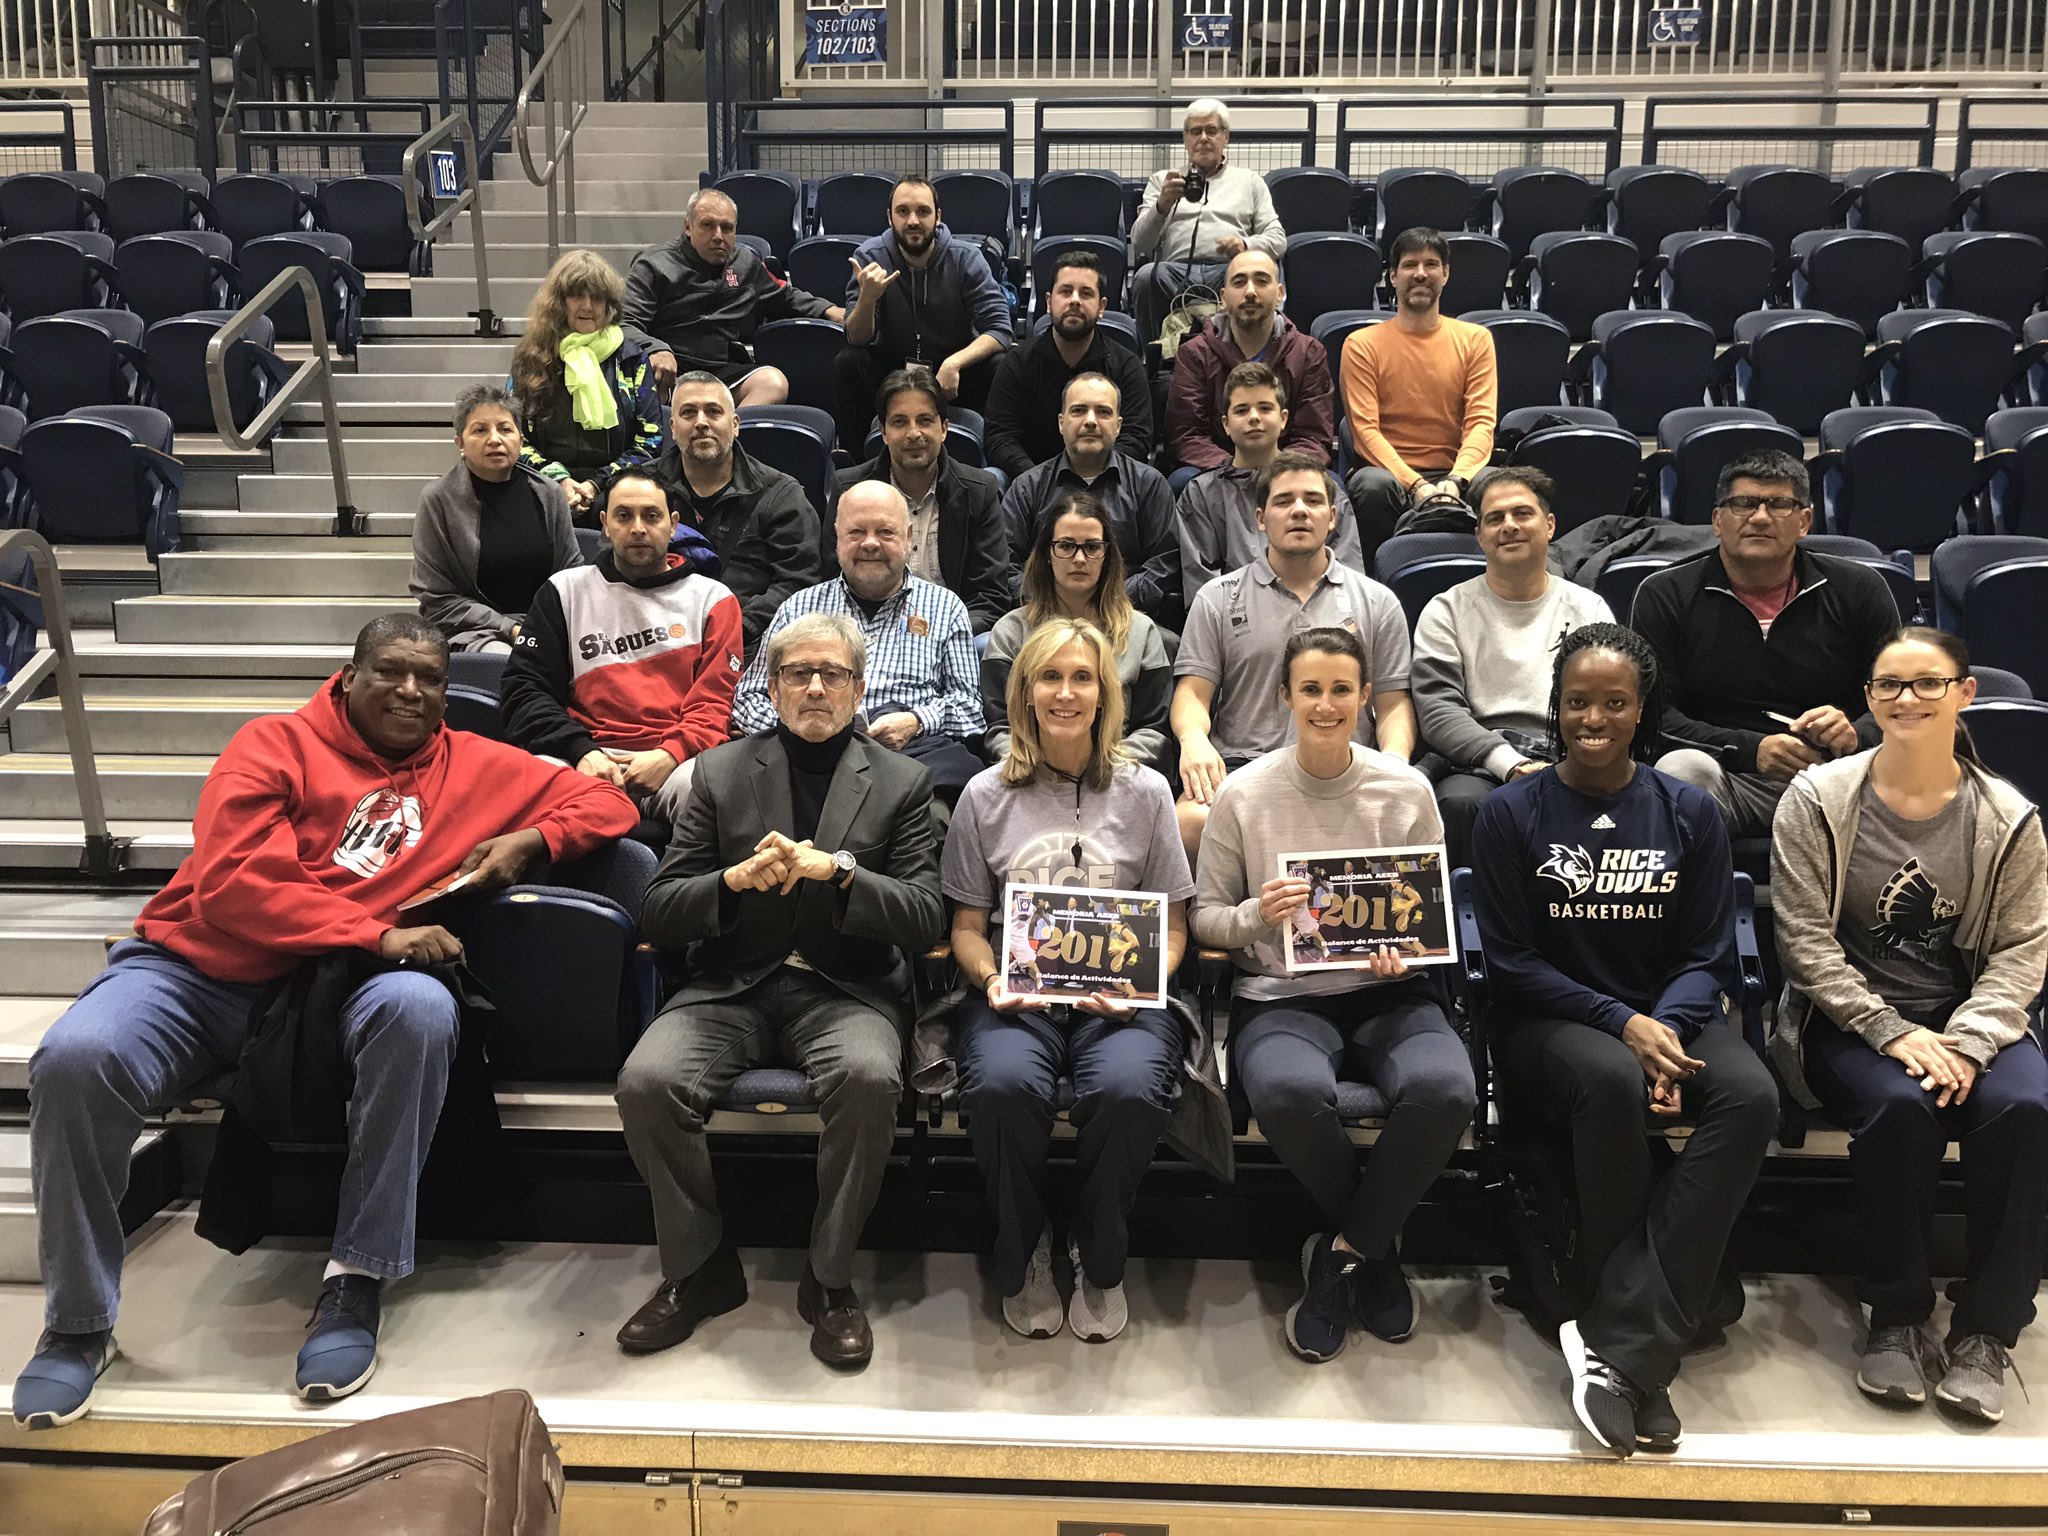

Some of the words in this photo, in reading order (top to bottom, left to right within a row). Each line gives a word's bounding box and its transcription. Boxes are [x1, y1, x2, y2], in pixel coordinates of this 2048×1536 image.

[816, 19, 876, 33] SECTIONS
[817, 37, 876, 55] 102/103
[437, 158, 456, 191] 103
[1600, 849, 1666, 870] RICE
[1329, 873, 1373, 882] MEMORIA
[1595, 871, 1679, 894] OWLS
[1549, 902, 1663, 919] BASKETBALL
[1321, 938, 1355, 947] Balance
[1355, 937, 1366, 945] de
[1367, 935, 1419, 944] Actividades
[1069, 973, 1080, 981] de
